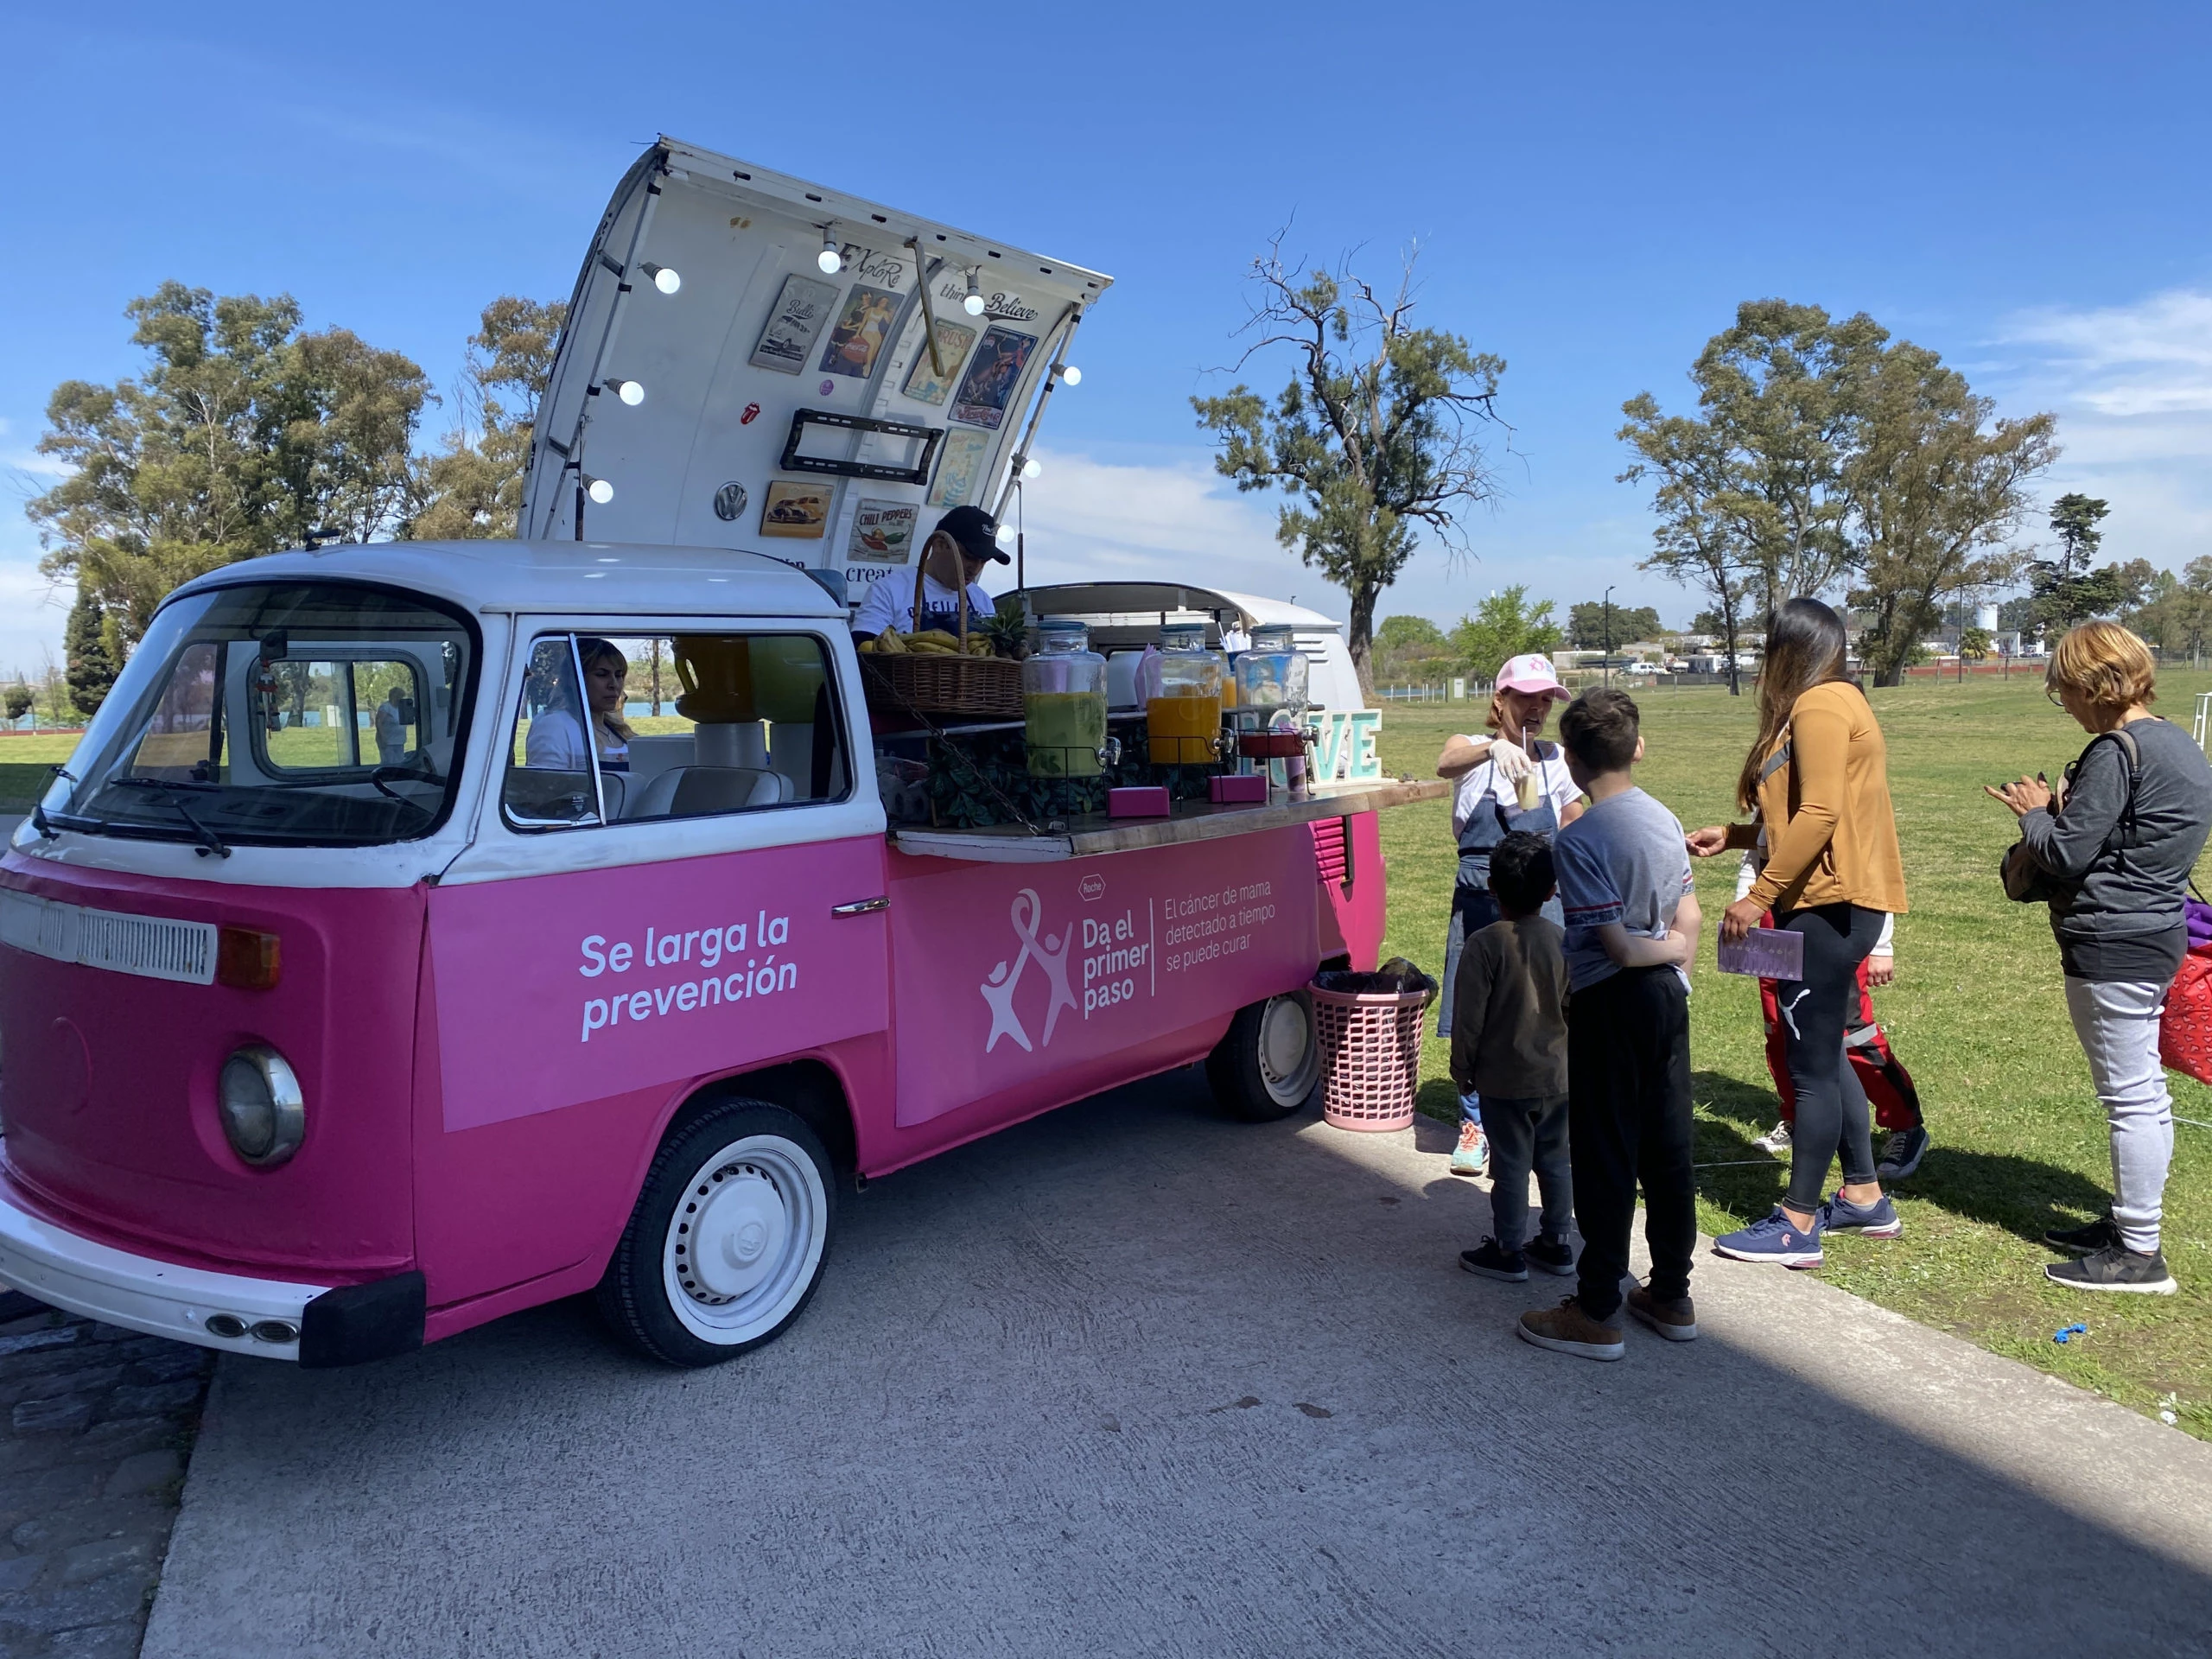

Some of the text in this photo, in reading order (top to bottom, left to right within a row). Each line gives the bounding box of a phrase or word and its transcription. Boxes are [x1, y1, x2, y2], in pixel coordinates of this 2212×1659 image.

[985, 292, 1039, 322] Believe
[859, 512, 880, 526] CHILI
[880, 508, 913, 523] PEPPERS
[1083, 881, 1102, 894] Roche
[1165, 881, 1271, 920] El cáncer de mama
[579, 910, 789, 977] Se larga la
[1083, 909, 1135, 949] Da el
[1166, 904, 1275, 946] detectado a tiempo
[1084, 943, 1149, 989] primer
[1166, 933, 1251, 972] se puede curar
[581, 955, 798, 1043] prevención
[1084, 978, 1135, 1020] paso
